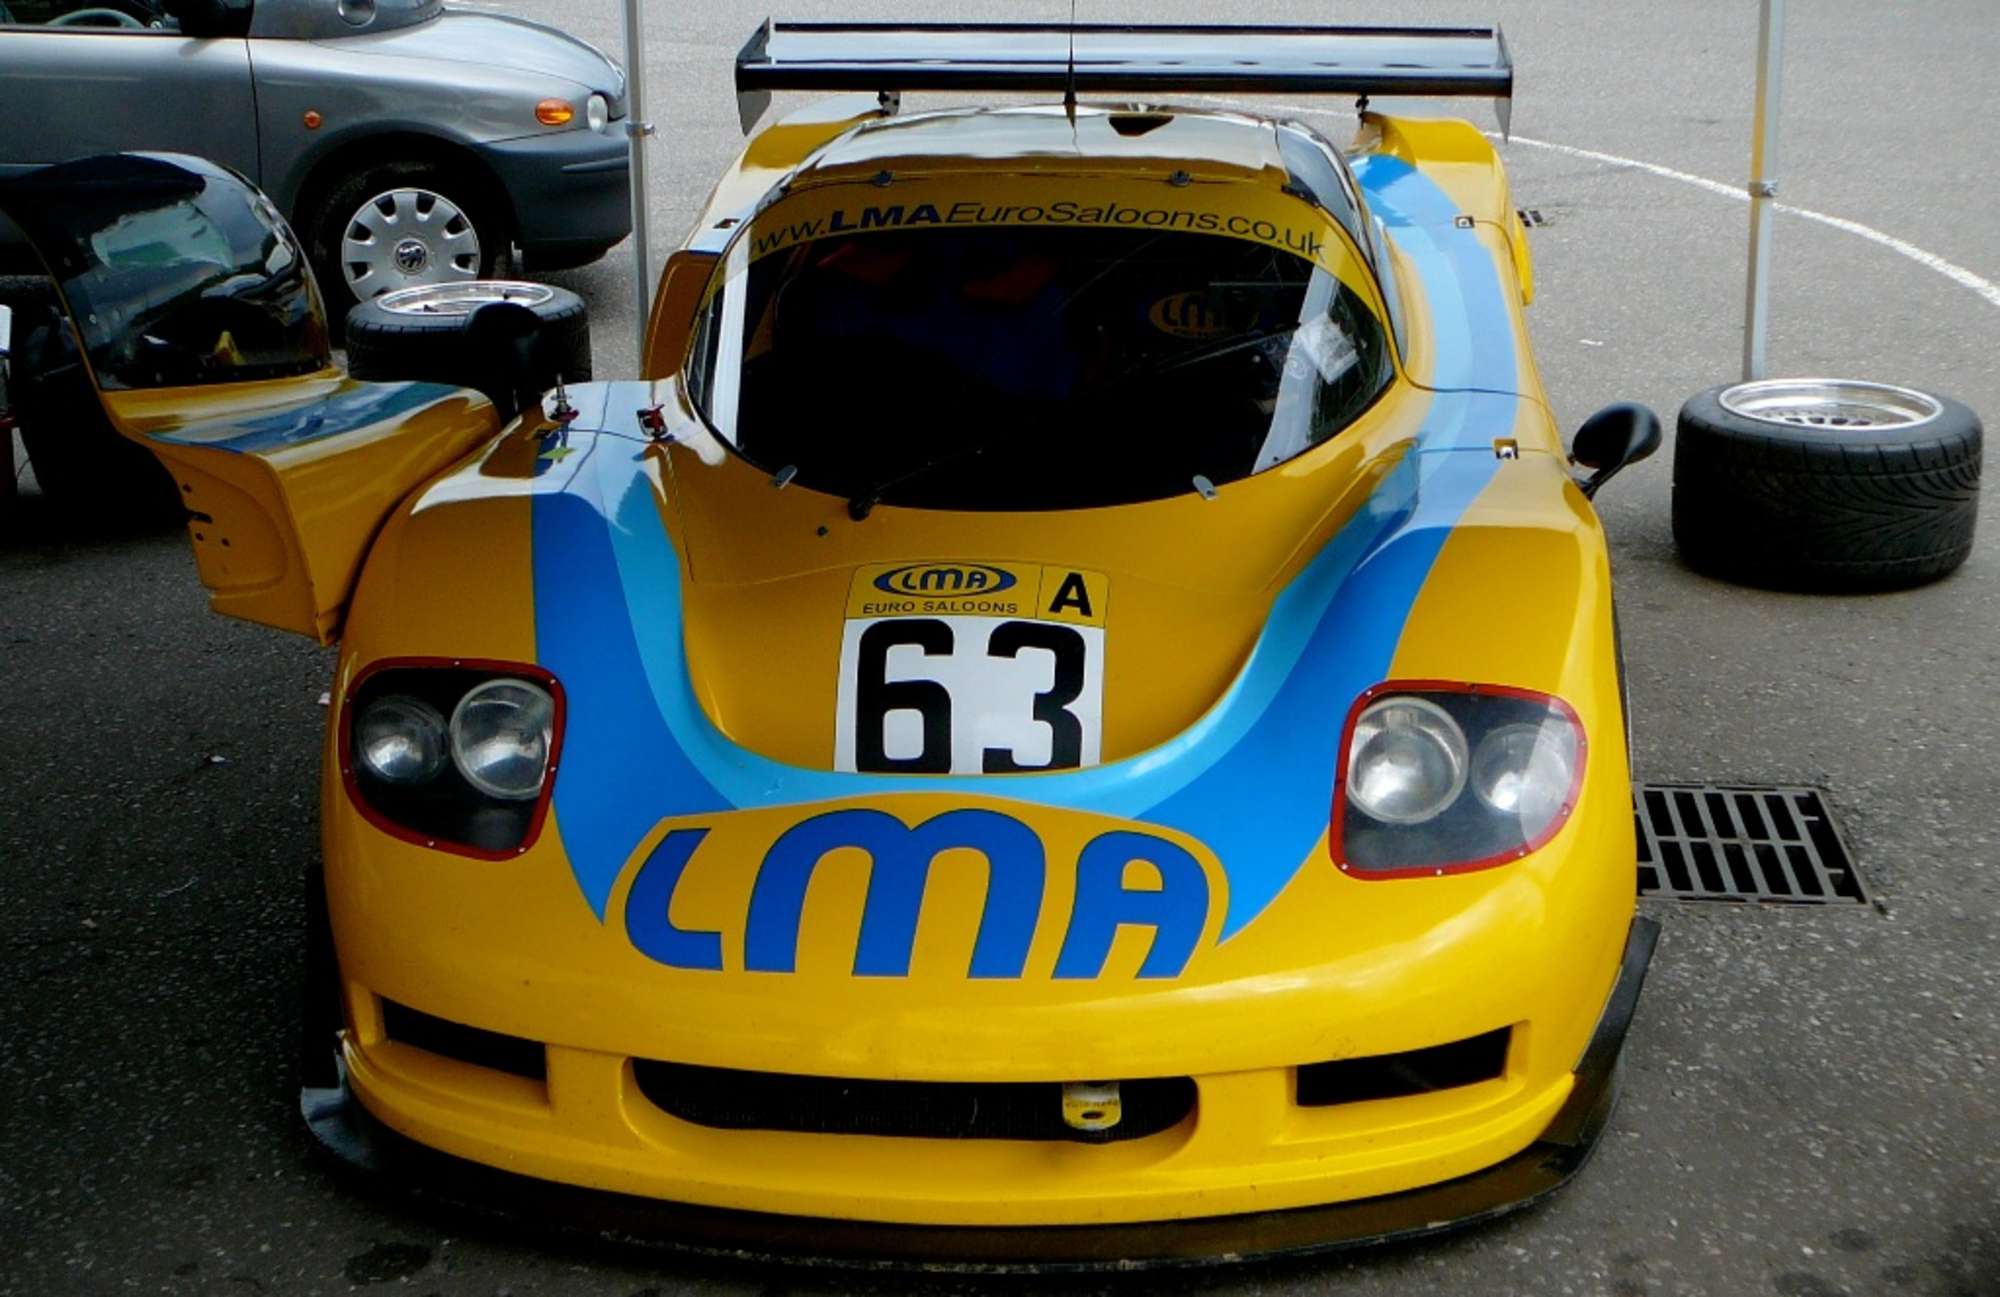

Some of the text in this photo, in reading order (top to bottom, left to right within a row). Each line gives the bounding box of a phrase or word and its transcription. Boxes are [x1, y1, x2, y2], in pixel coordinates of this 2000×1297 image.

[750, 202, 1325, 263] ww.LMAEuroSaloons.co.uk
[901, 567, 989, 591] LMA
[1047, 572, 1093, 617] A
[862, 601, 1018, 614] EURO SALOONS
[855, 618, 1087, 774] 63
[624, 807, 1211, 980] LMA
